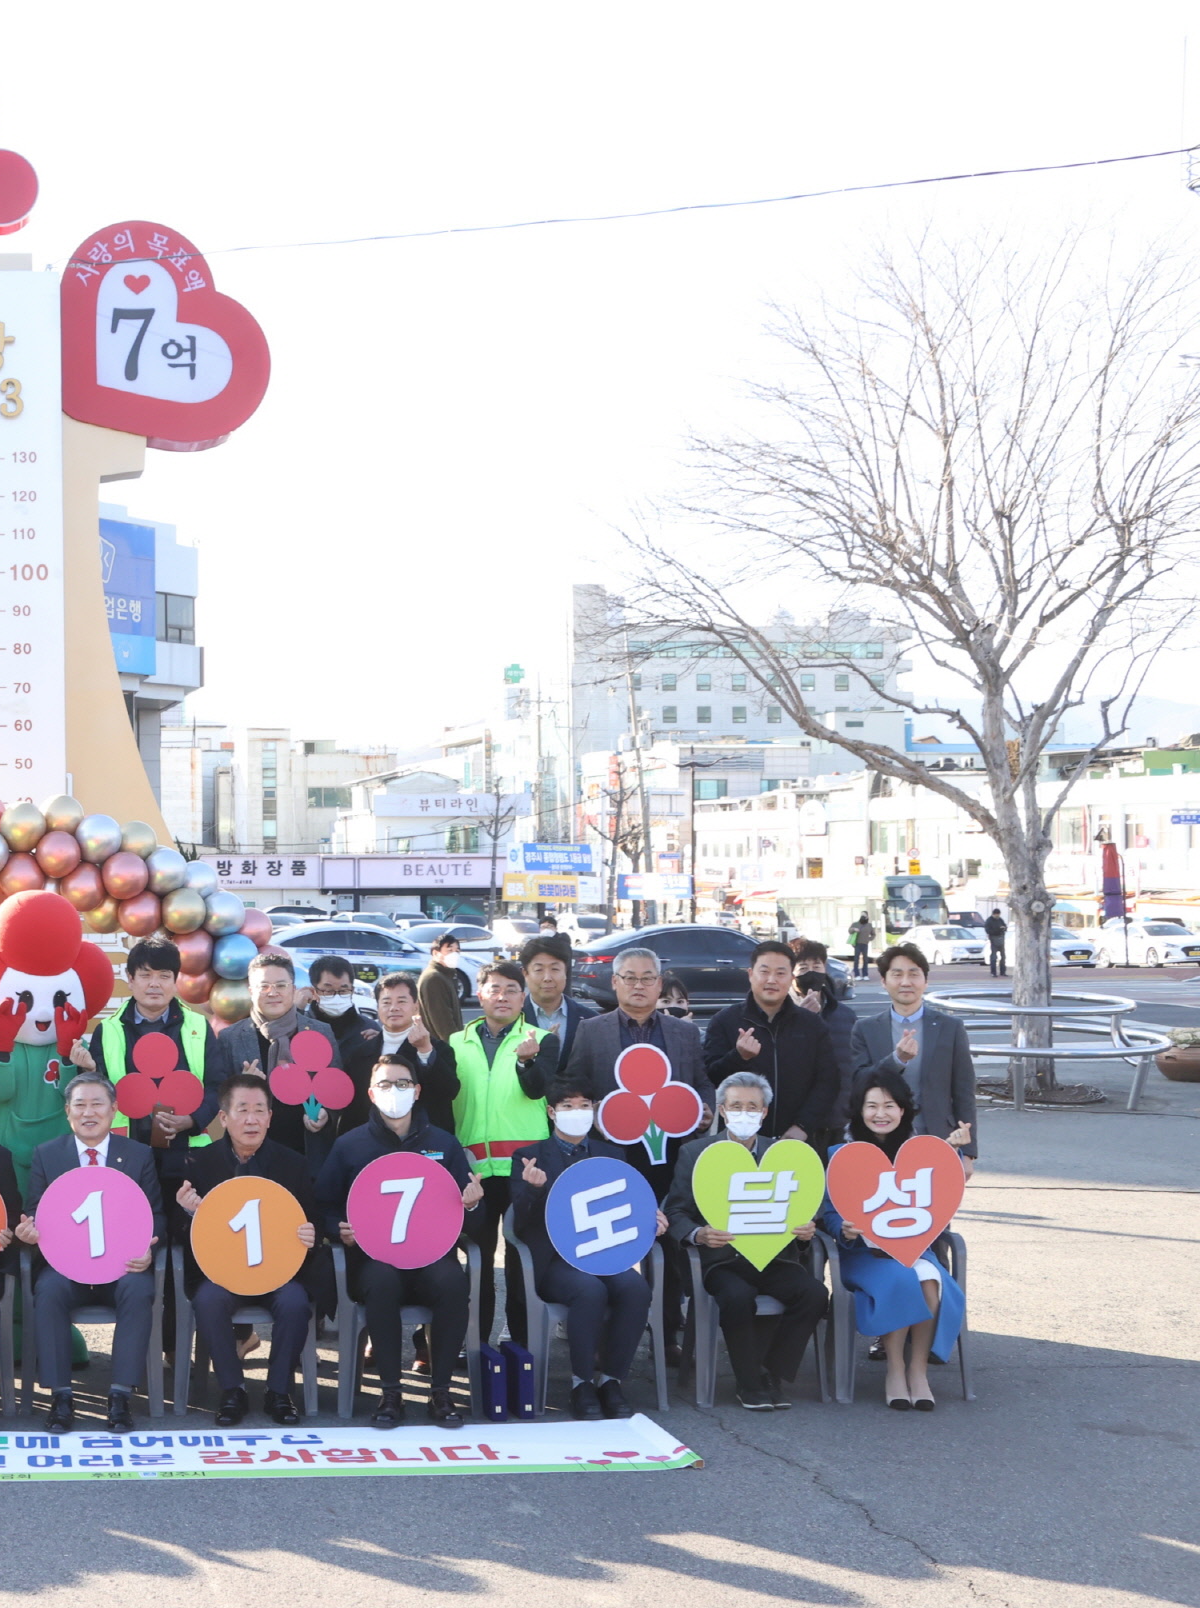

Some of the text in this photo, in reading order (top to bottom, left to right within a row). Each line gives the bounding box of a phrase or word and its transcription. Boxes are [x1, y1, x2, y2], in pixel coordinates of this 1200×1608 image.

[75, 229, 206, 294] 사랑의 목표액
[11, 452, 38, 464] 130
[11, 491, 38, 502] 120
[12, 529, 36, 540] 110
[10, 564, 49, 581] 100
[12, 606, 31, 617] 90
[13, 643, 32, 655] 80
[14, 682, 31, 694] 70
[14, 720, 32, 731] 60
[15, 758, 33, 770] 50
[418, 798, 479, 813] 뷰티라인
[216, 860, 307, 877] 방화장품
[403, 860, 472, 877] BEAUTÉ
[538, 884, 577, 898] 벚꽃마라톤
[380, 1177, 425, 1244] 7
[726, 1169, 798, 1238] 달
[862, 1166, 934, 1239] 성
[71, 1190, 106, 1259] 1
[570, 1177, 639, 1259] 도
[228, 1199, 263, 1267] 1
[27, 1453, 175, 1468] 여러분
[198, 1443, 520, 1465] 감사합니다.
